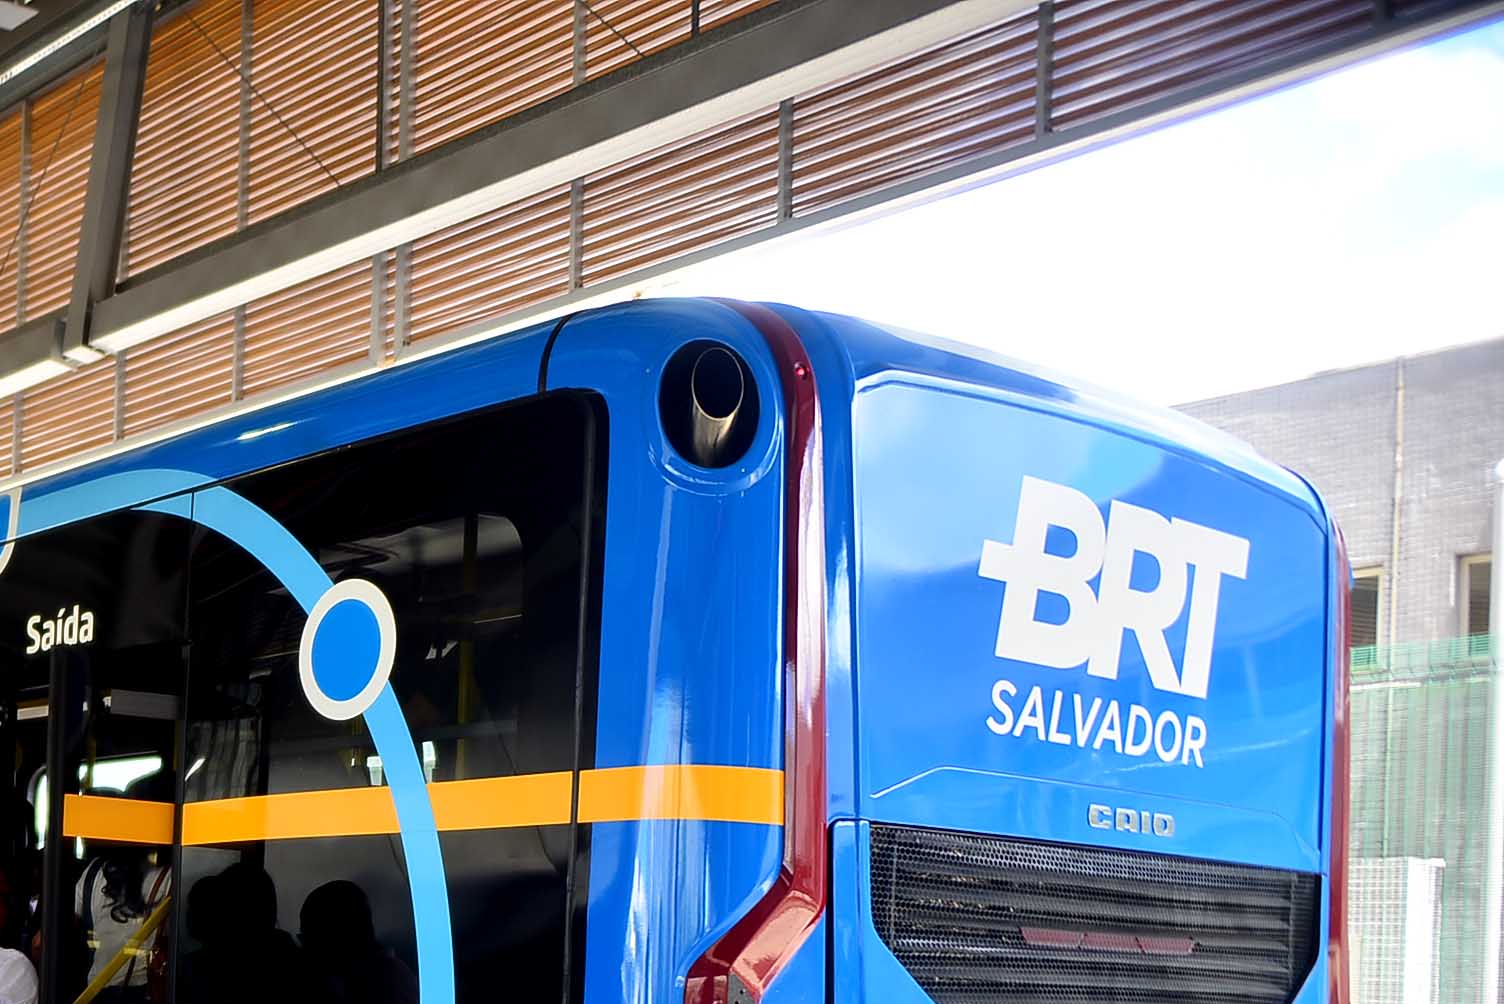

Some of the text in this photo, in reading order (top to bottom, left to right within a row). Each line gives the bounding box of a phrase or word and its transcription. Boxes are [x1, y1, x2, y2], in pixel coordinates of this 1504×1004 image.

[978, 474, 1251, 700] BRT
[26, 604, 94, 655] Saída
[986, 679, 1208, 769] SALVADOR
[1088, 803, 1176, 838] CAIO
